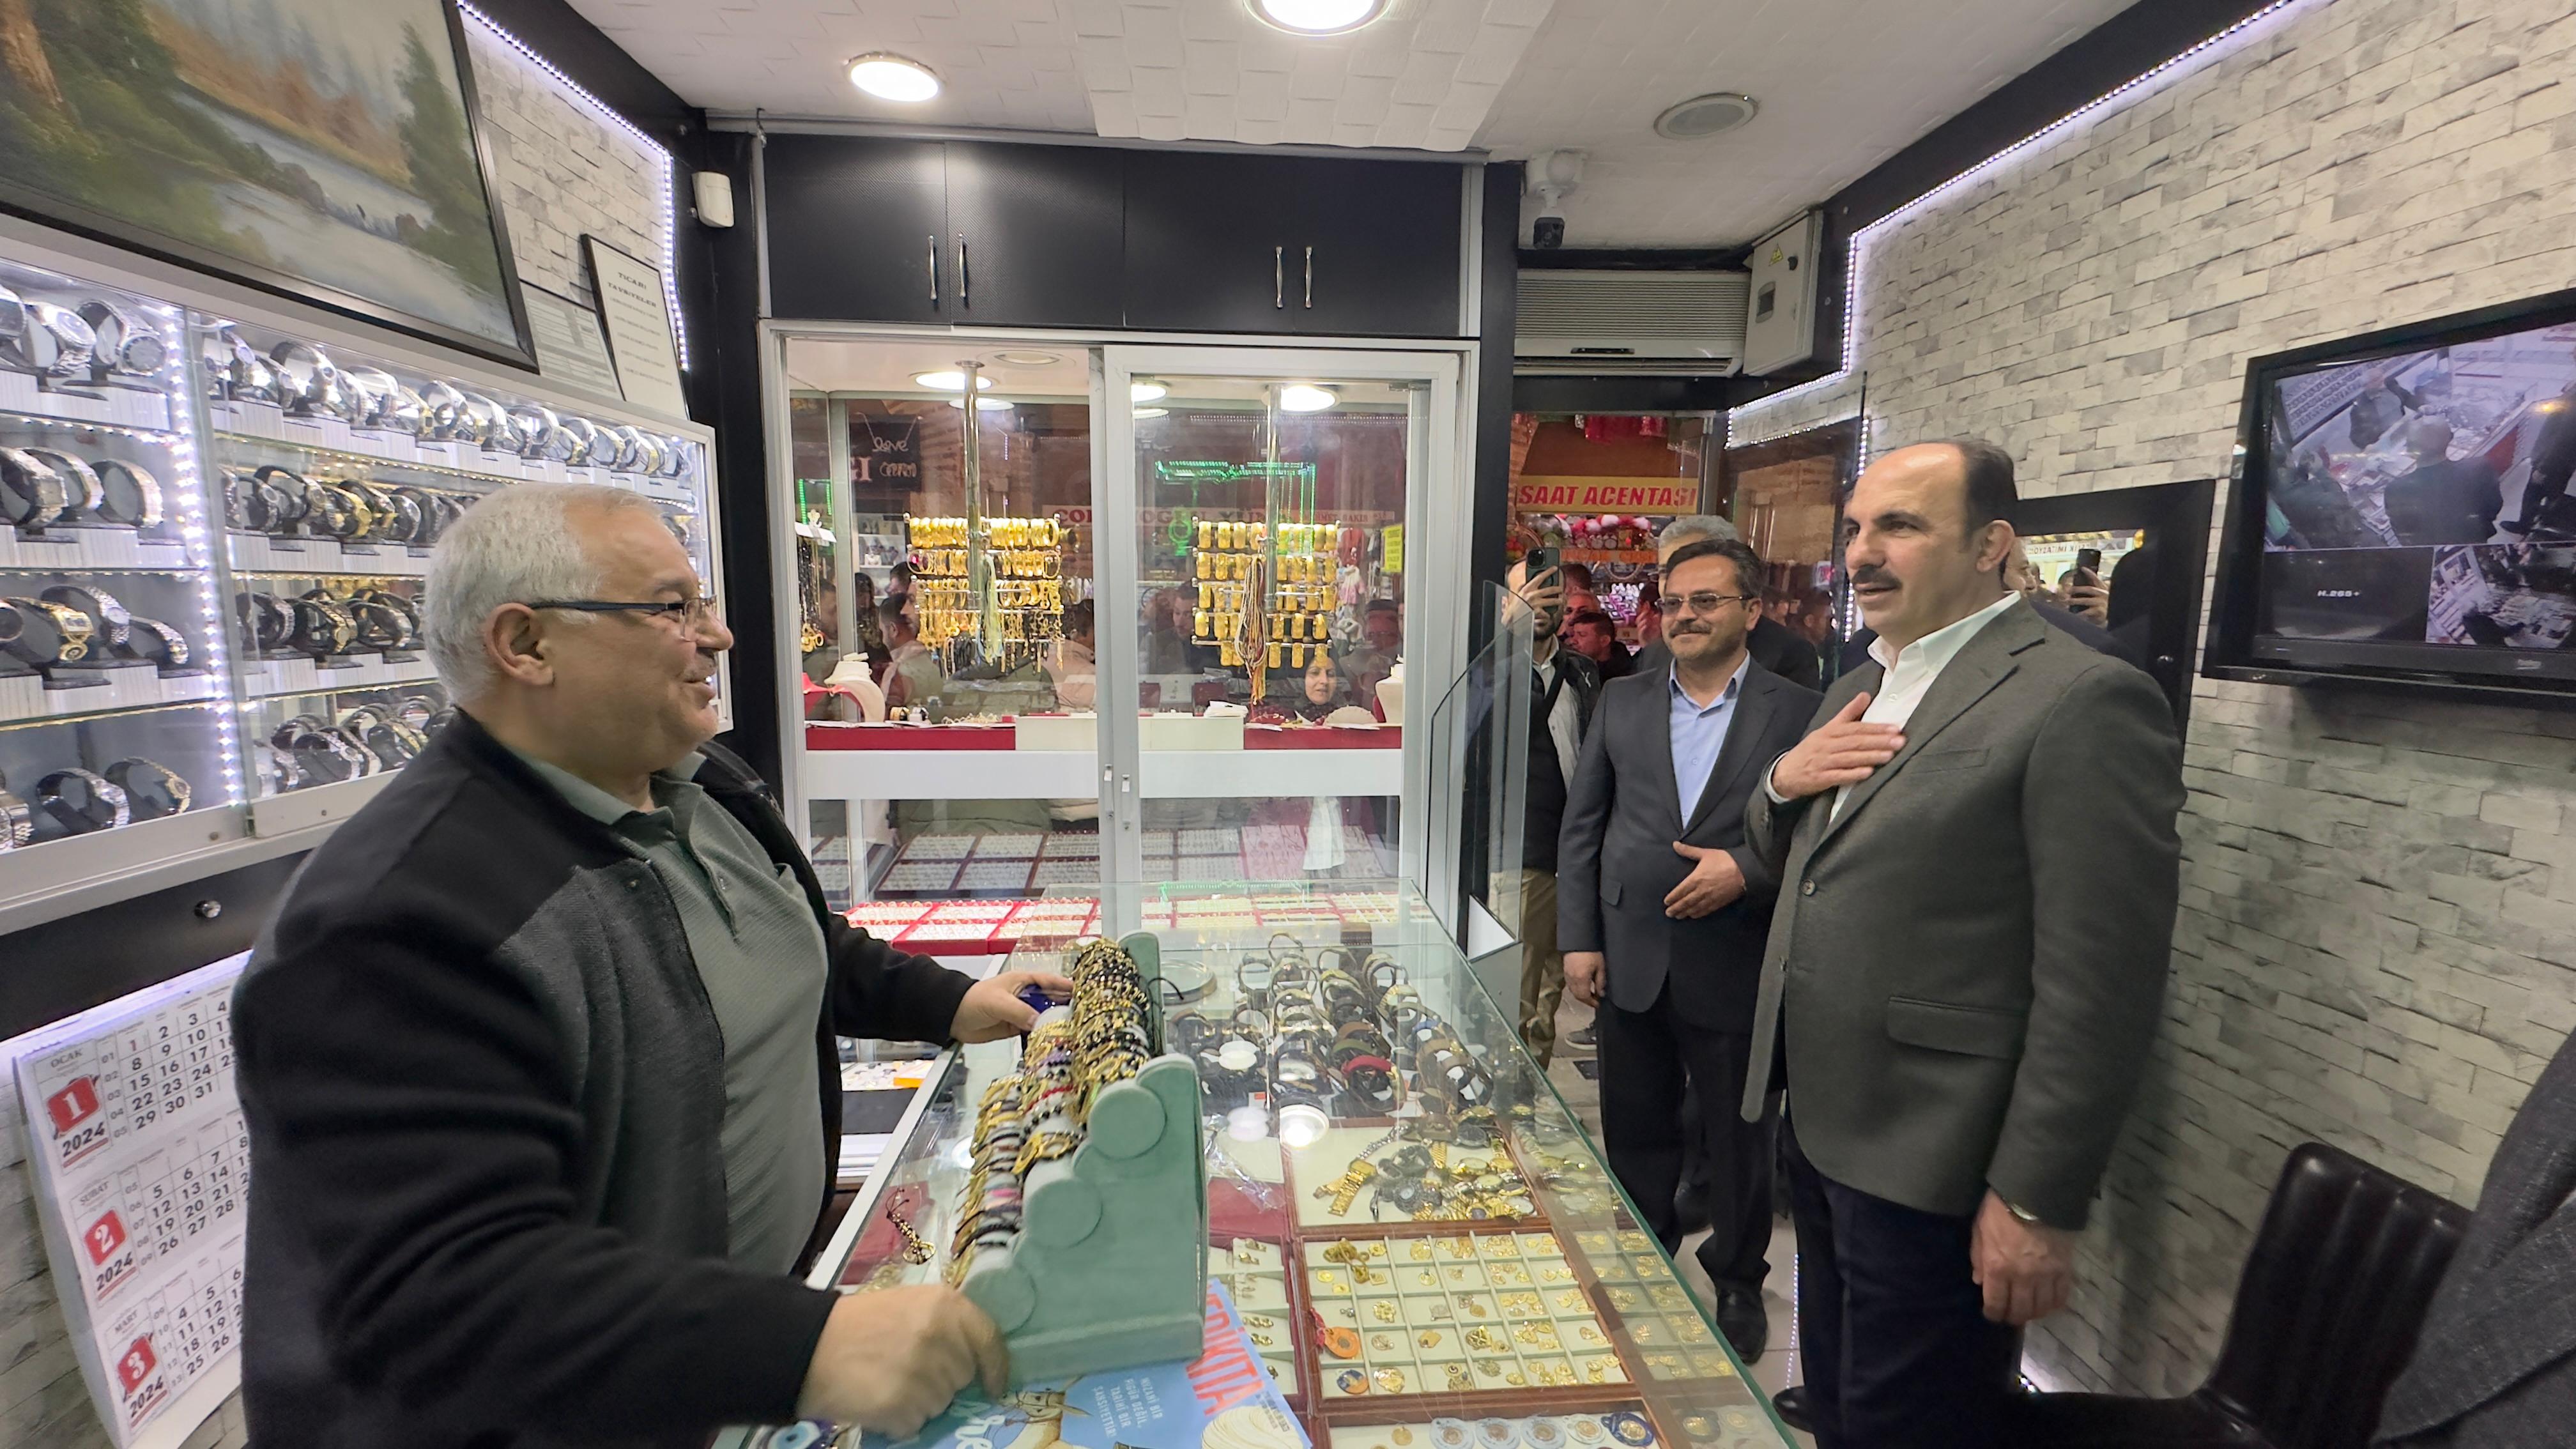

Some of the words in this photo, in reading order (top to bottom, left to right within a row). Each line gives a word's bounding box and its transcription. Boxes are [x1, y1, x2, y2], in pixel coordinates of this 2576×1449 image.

[1519, 485, 1579, 505] SAAT
[1583, 486, 1696, 507] ACENTASI
[2317, 589, 2360, 597] H.265+
[101, 1052, 115, 1064] 01
[130, 1039, 137, 1052] 1
[160, 1026, 169, 1039] 2
[188, 1013, 199, 1025] 3
[217, 1001, 227, 1012] 4
[50, 1048, 83, 1068] OCAK
[104, 1071, 118, 1082] 02
[132, 1057, 141, 1071] 8
[162, 1044, 171, 1056] 9
[188, 1029, 206, 1045] 10
[107, 1089, 121, 1101] 03
[130, 1073, 151, 1091] 15
[160, 1062, 180, 1077] 16
[190, 1046, 208, 1062] 17
[63, 1092, 85, 1120] 1
[110, 1108, 124, 1120] 04
[132, 1092, 153, 1111] 22
[162, 1078, 182, 1096] 23
[192, 1063, 211, 1082] 24
[135, 1110, 156, 1130] 29
[165, 1096, 185, 1114] 30
[194, 1082, 213, 1099] 31
[62, 1121, 105, 1158] 2024
[238, 1121, 244, 1130] 1
[153, 1185, 162, 1199] 5
[184, 1168, 193, 1180] 6
[211, 1151, 220, 1164] 7
[239, 1137, 248, 1147] 8
[153, 1200, 171, 1218] 12
[183, 1183, 201, 1200] 13
[210, 1166, 228, 1182] 14
[156, 1218, 174, 1236] 19
[185, 1200, 204, 1218] 20
[212, 1184, 229, 1201] 21
[95, 1224, 114, 1254] 2
[159, 1238, 178, 1256] 26
[188, 1216, 206, 1236] 27
[215, 1200, 234, 1219] 28
[96, 1252, 133, 1291] 2024
[179, 1307, 188, 1319] 4
[206, 1286, 215, 1300] 5
[233, 1269, 241, 1280] 6
[114, 1310, 138, 1333] MART
[179, 1322, 194, 1340] 11
[206, 1300, 223, 1319] 12
[183, 1338, 200, 1357] 18
[209, 1317, 226, 1335] 19
[127, 1352, 145, 1379] 3
[187, 1354, 204, 1376] 25
[212, 1333, 230, 1354] 26
[129, 1376, 164, 1418] 2024
